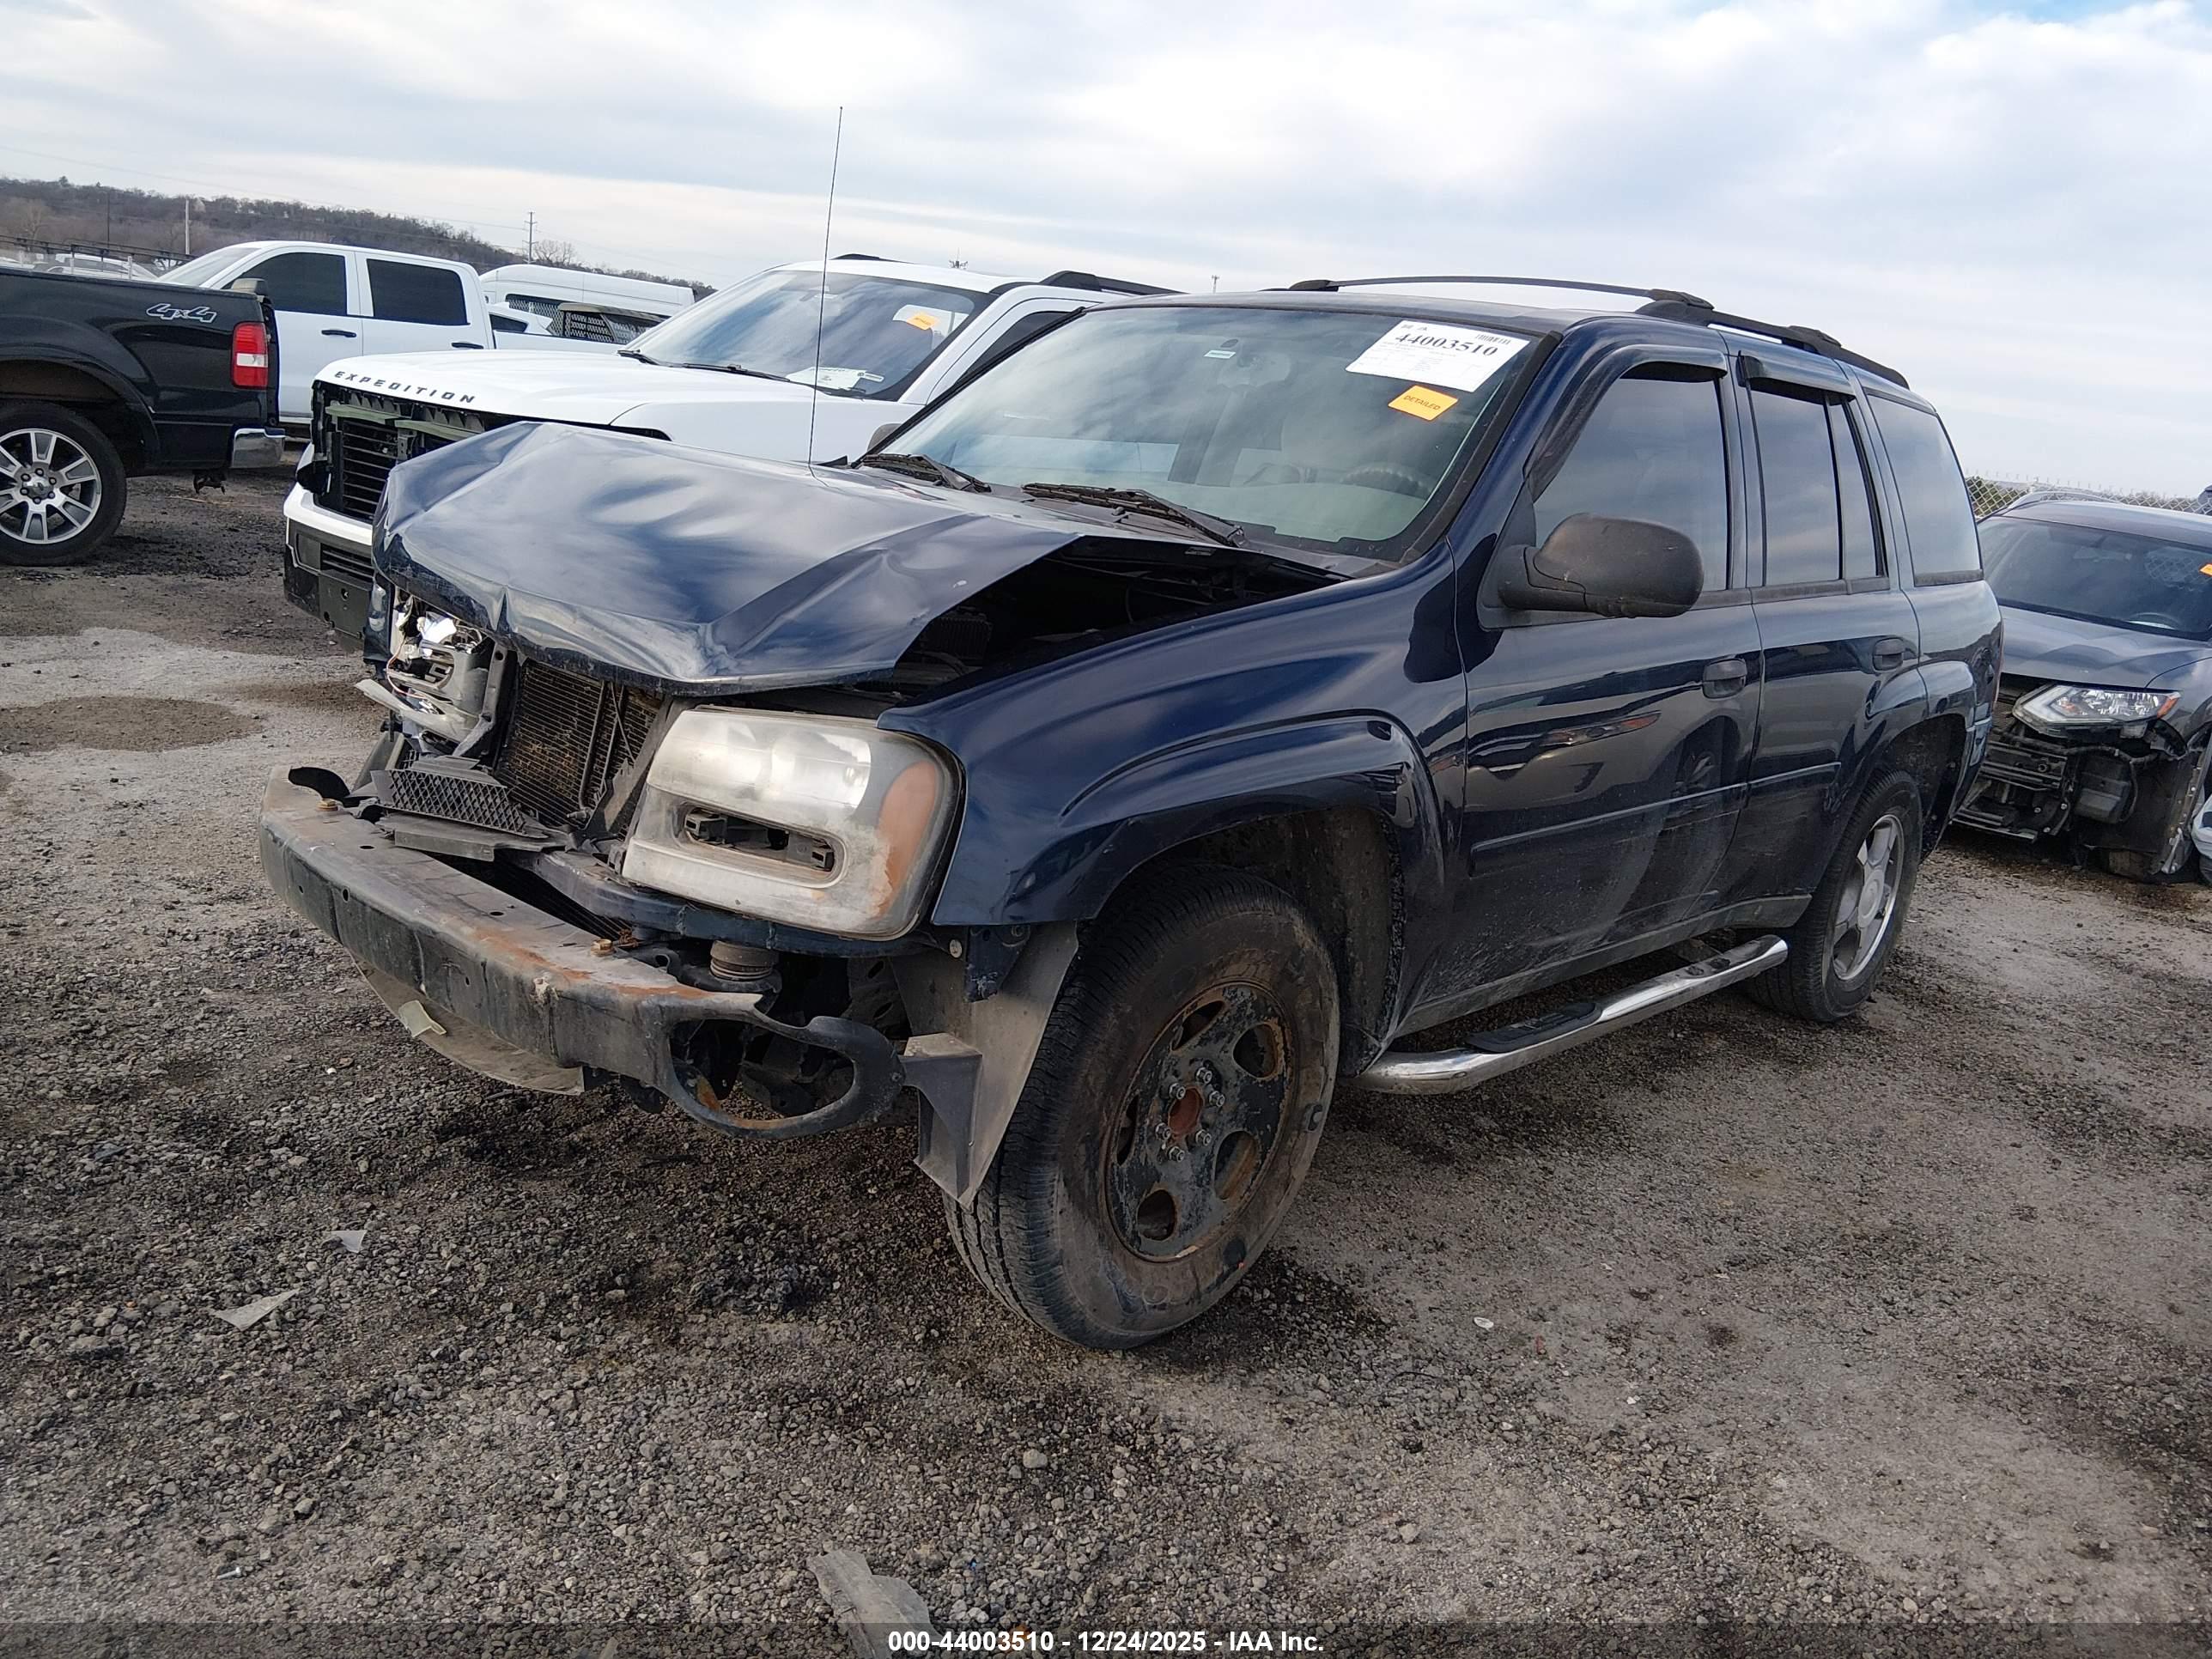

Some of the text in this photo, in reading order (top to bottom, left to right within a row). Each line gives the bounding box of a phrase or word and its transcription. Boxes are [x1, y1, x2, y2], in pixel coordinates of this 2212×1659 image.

[146, 303, 217, 323] 4x4
[1395, 332, 1498, 356] 44003510
[334, 371, 476, 404] EXPEDITION
[1403, 394, 1441, 410] DETAILED
